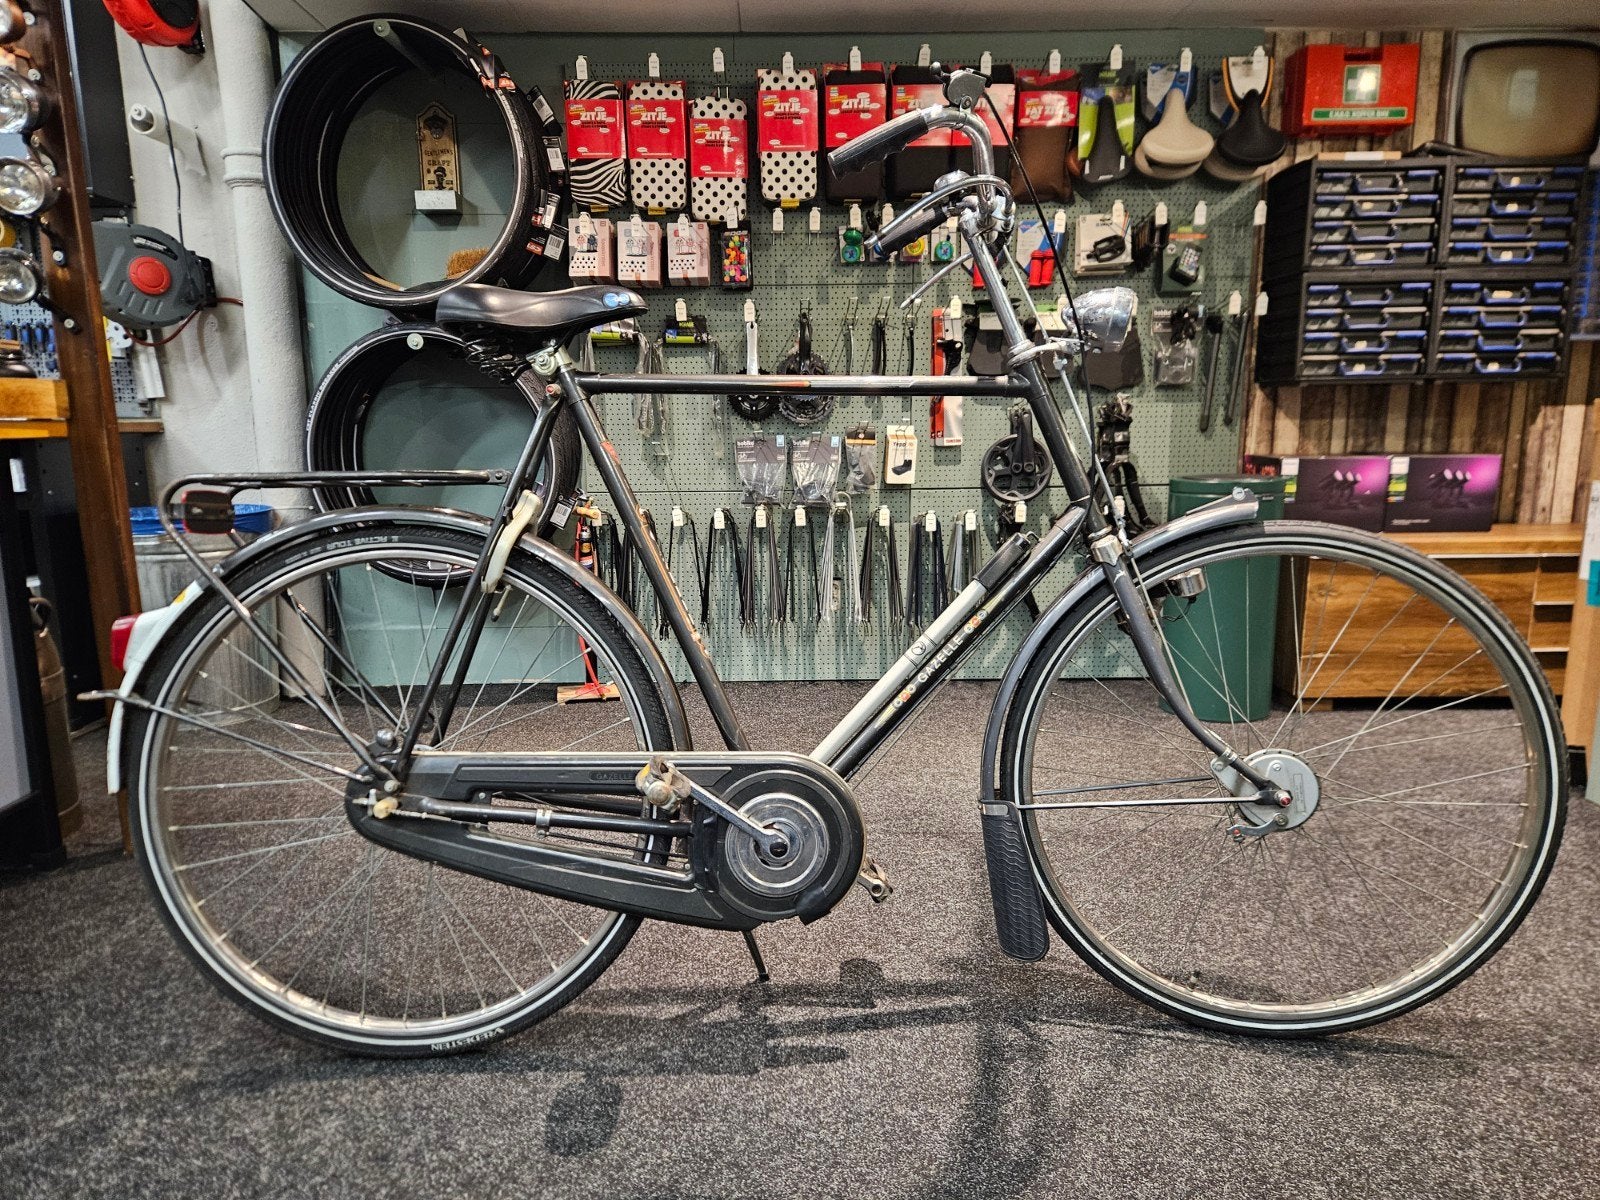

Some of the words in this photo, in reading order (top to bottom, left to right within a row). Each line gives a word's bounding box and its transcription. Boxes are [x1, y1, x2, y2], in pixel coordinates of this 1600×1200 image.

[774, 103, 801, 112] ZITJE
[842, 98, 870, 109] ZITJE
[580, 112, 607, 121] ZITJE
[641, 112, 668, 121] ZITJE
[705, 131, 732, 140] ZITJE
[326, 539, 353, 551] TOUR
[917, 634, 964, 684] GAZELLE
[596, 772, 633, 781] GAZELLE
